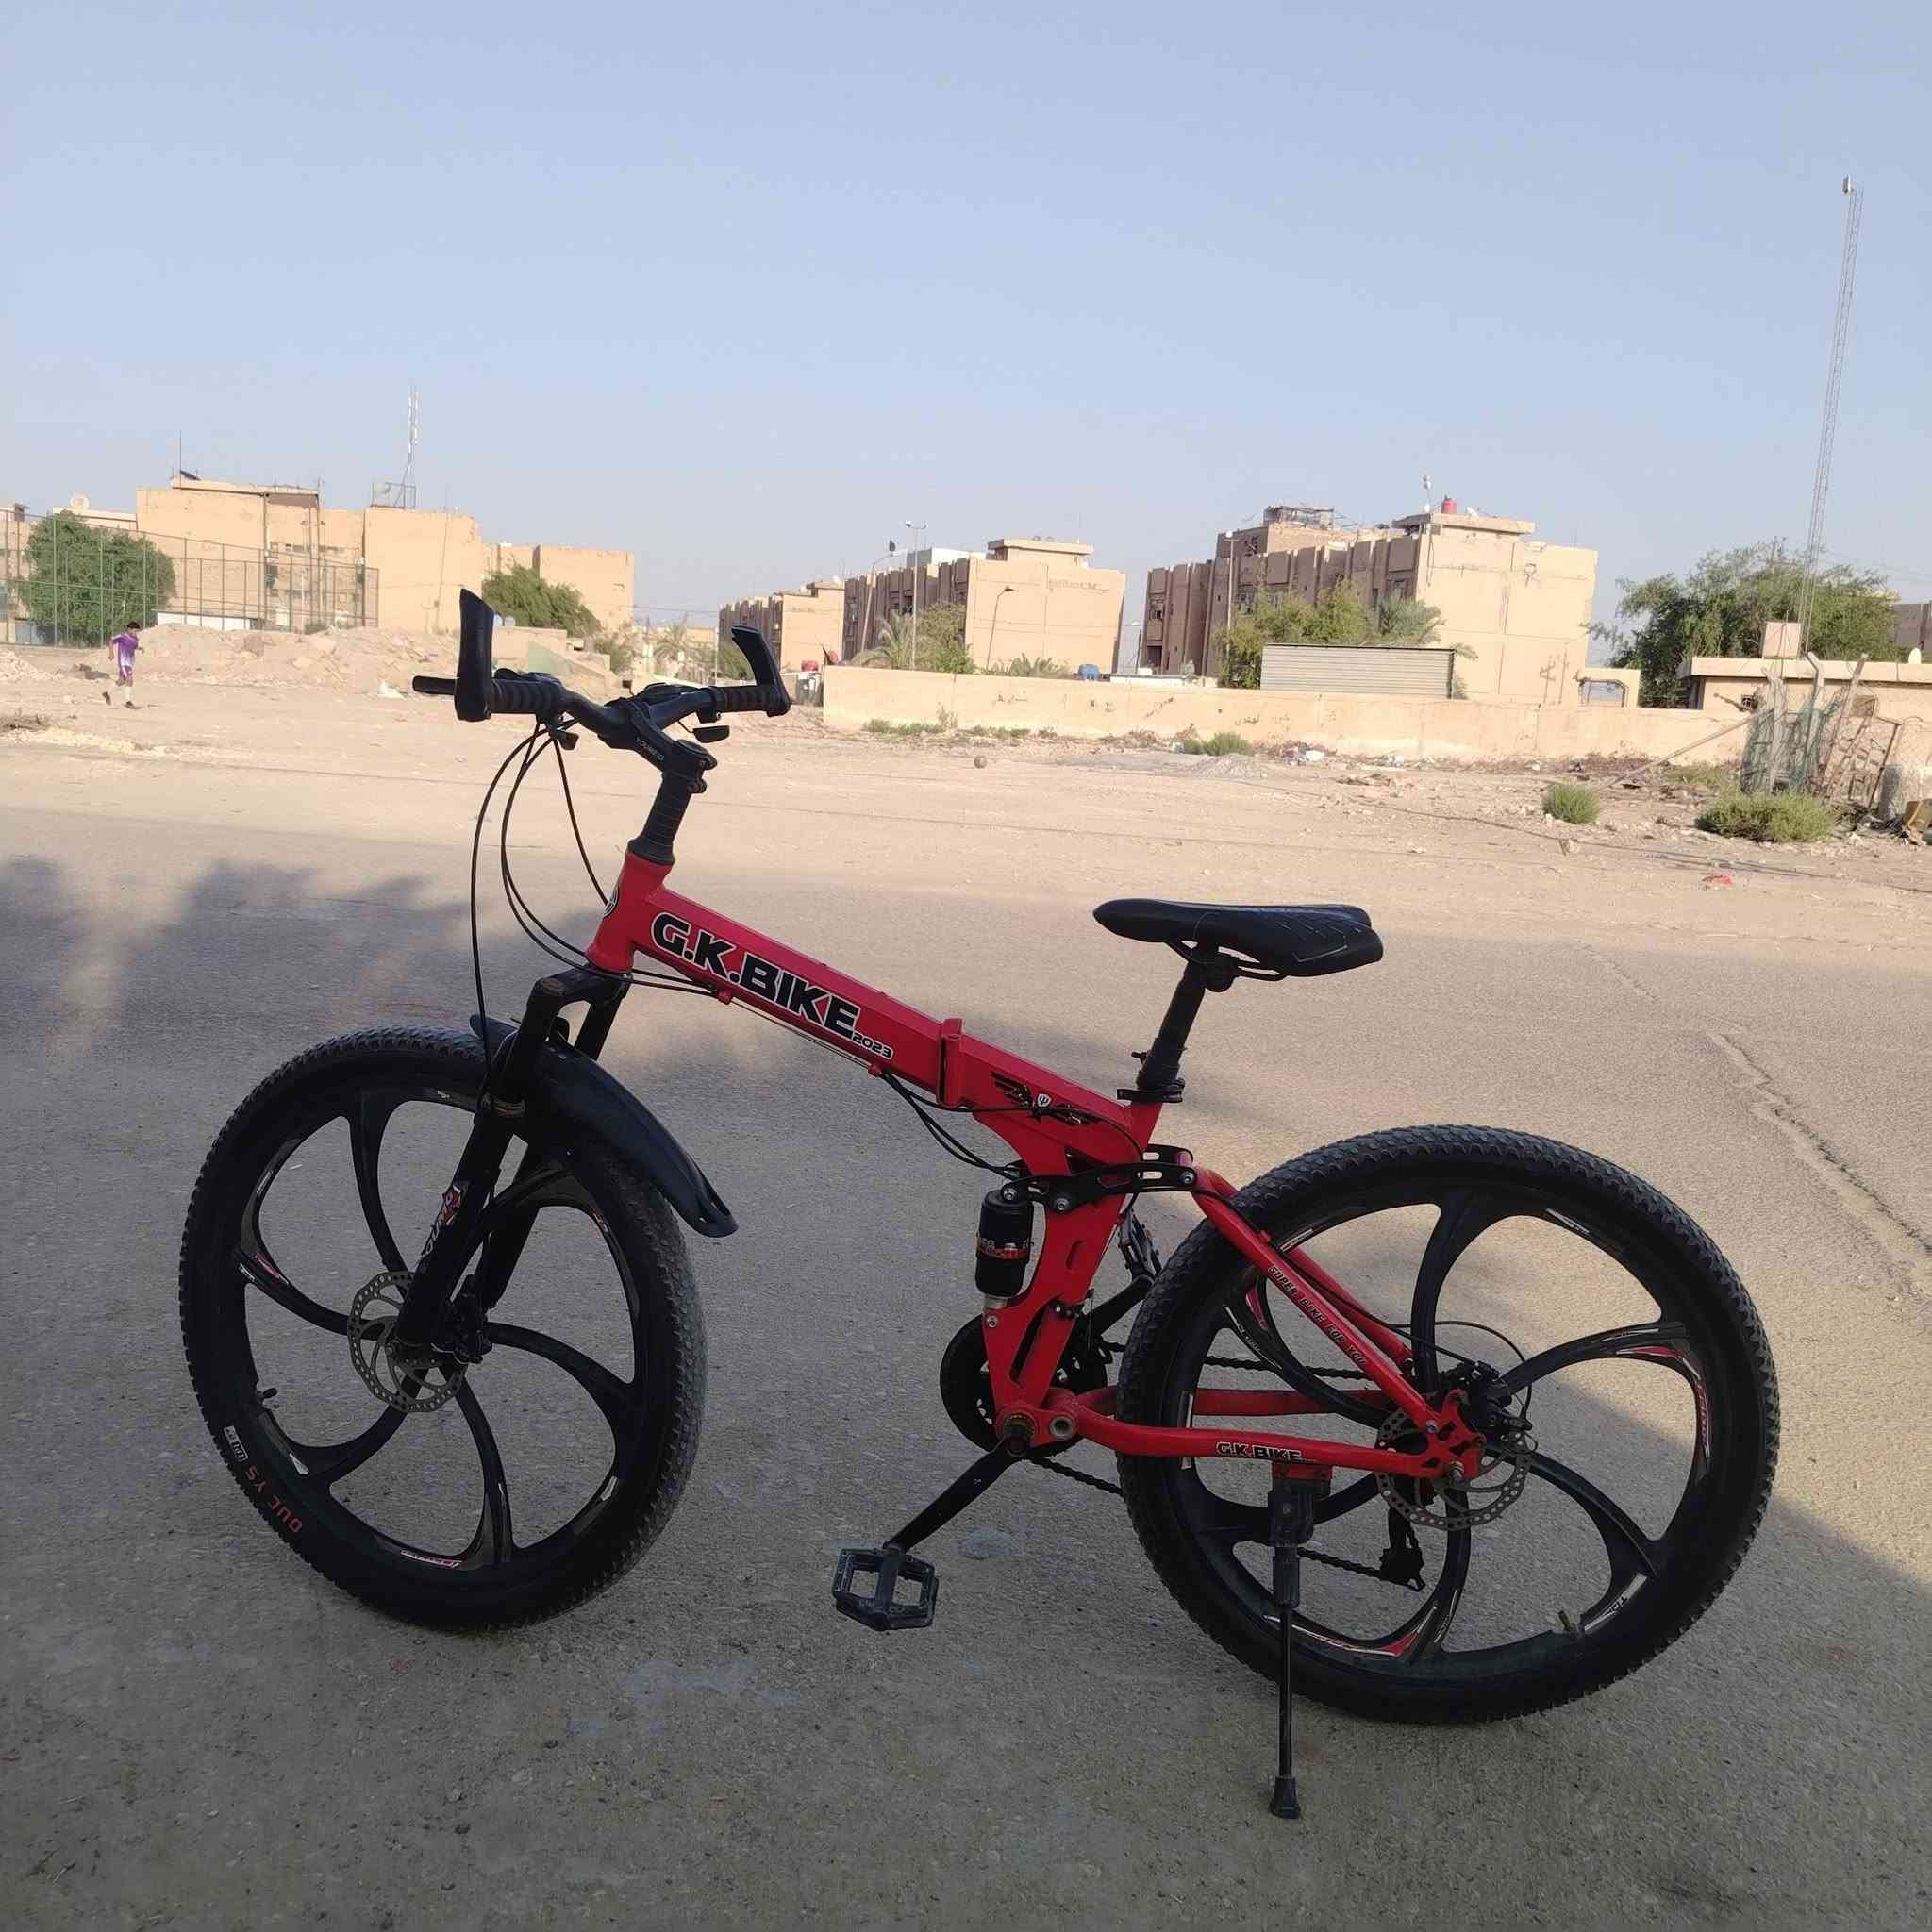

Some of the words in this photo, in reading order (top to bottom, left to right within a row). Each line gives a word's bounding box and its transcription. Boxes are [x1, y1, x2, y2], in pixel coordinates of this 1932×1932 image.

[651, 912, 861, 1041] G.K.BIKE
[852, 1032, 894, 1060] 2023
[1268, 1265, 1299, 1296] SUPER
